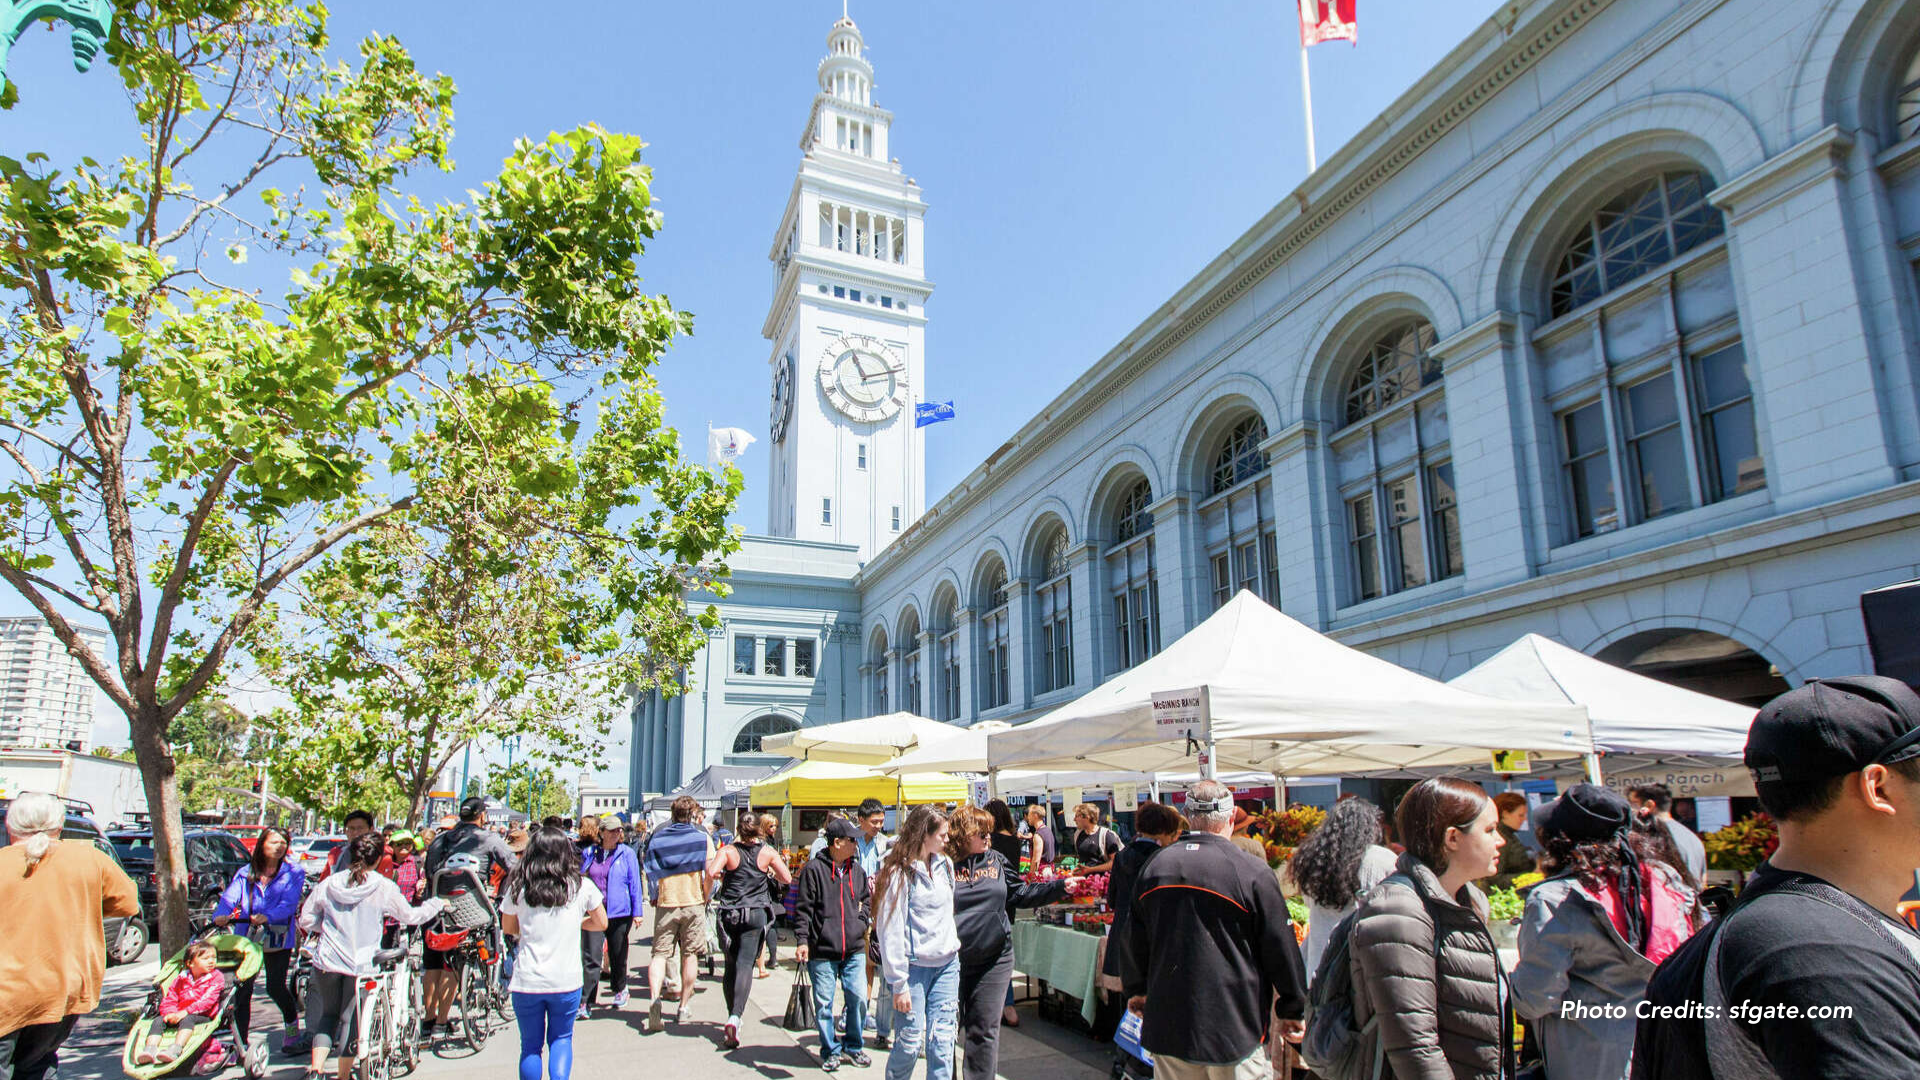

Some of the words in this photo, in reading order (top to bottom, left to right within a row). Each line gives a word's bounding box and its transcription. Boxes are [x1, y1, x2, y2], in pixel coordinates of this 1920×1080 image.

[1181, 698, 1200, 708] RANCH
[1665, 772, 1724, 785] Ranch
[1680, 785, 1699, 794] CA
